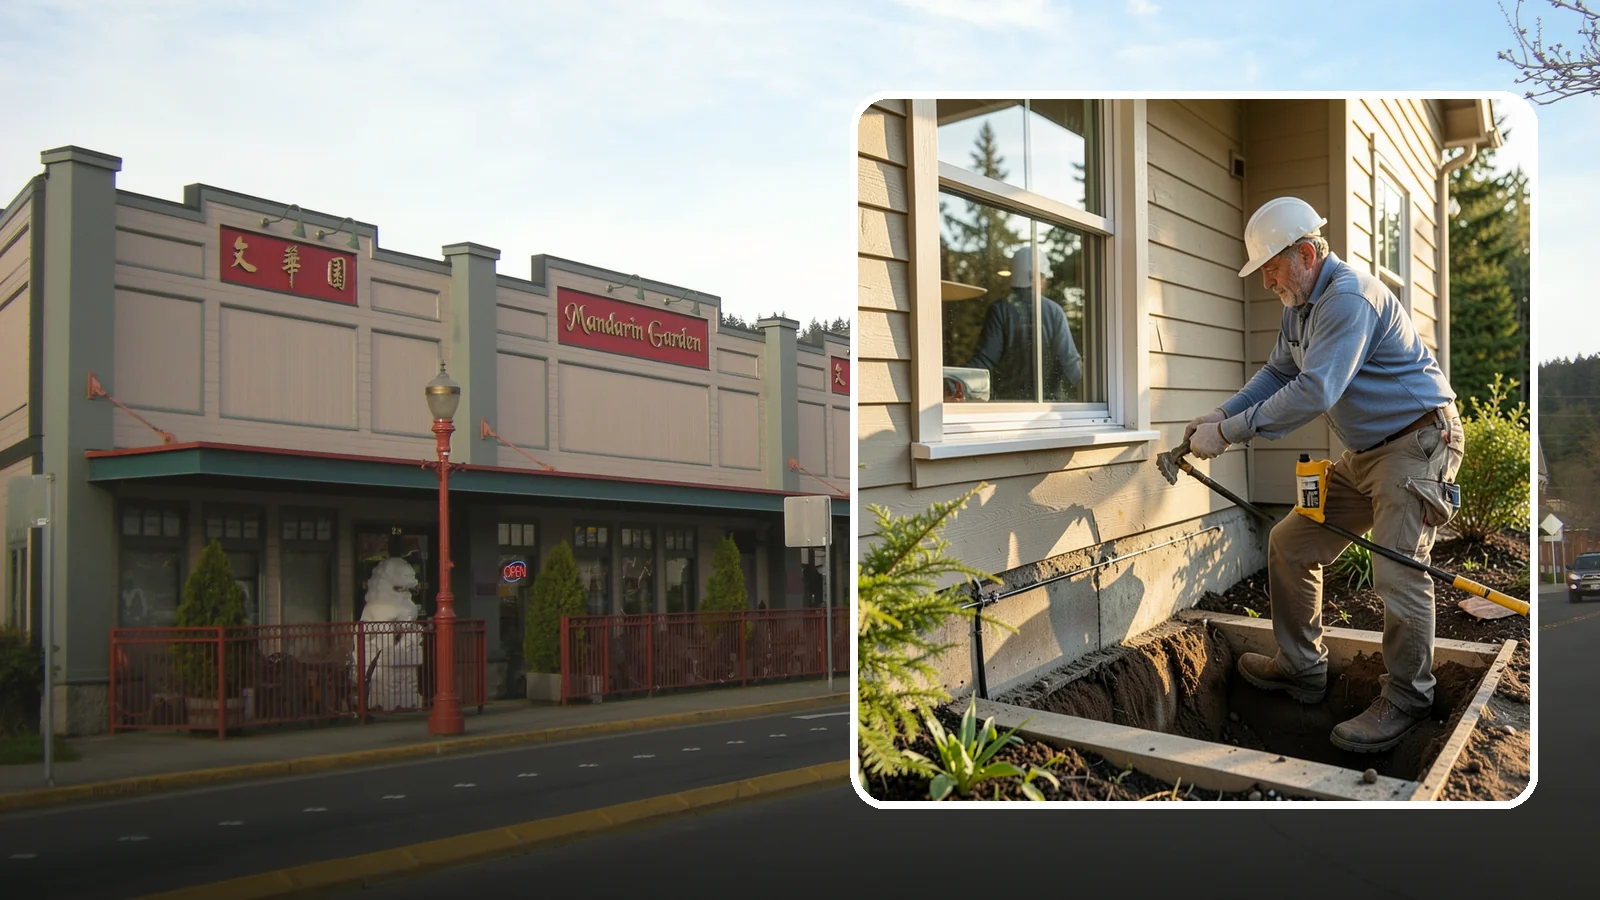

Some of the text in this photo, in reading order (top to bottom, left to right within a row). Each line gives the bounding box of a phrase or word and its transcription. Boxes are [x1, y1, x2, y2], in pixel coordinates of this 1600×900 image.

[564, 302, 702, 352] Mandarin Garden
[503, 565, 527, 578] OPEN
